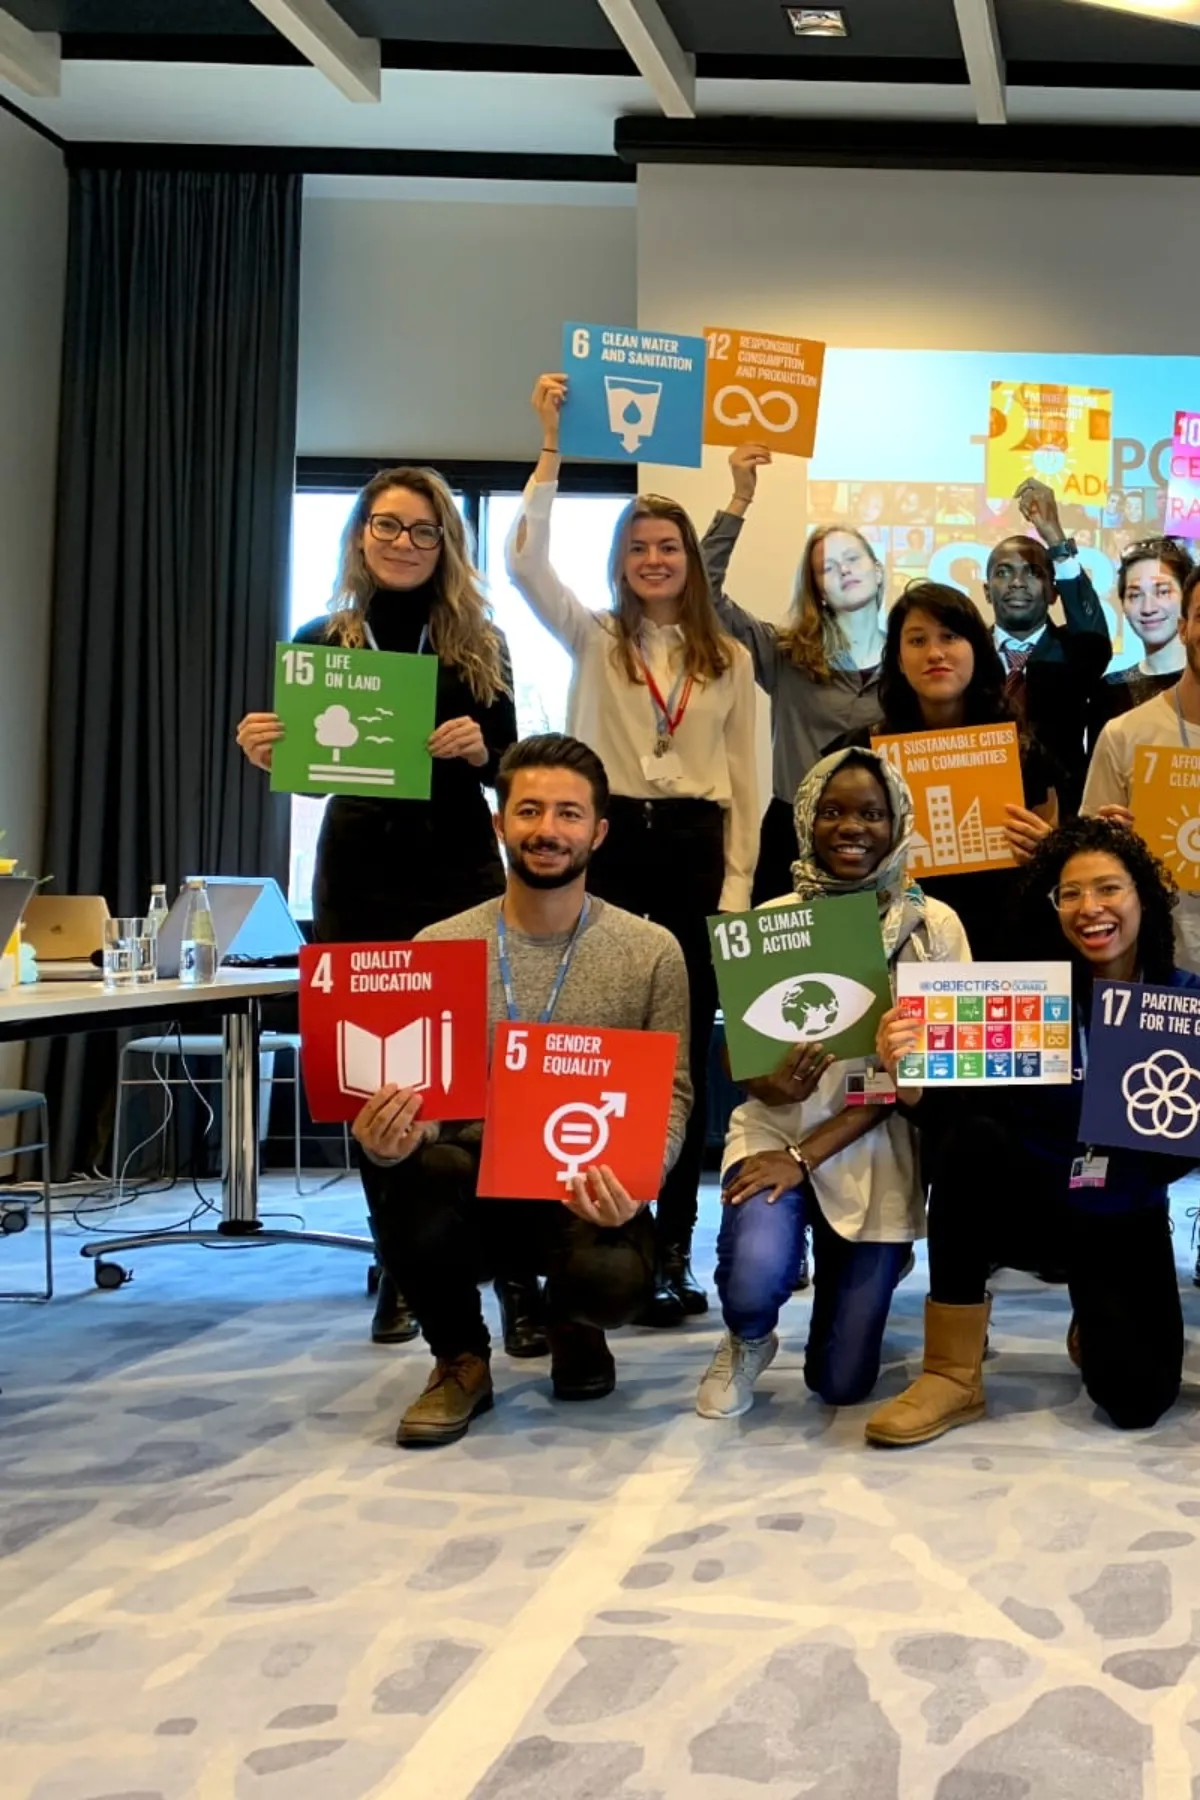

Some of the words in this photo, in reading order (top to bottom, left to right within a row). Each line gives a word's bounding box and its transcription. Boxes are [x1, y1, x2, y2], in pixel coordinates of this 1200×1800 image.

[572, 329, 591, 359] 6
[602, 331, 638, 349] CLEAN
[641, 336, 679, 353] WATER
[707, 332, 731, 360] 12
[602, 350, 625, 363] AND
[628, 352, 692, 372] SANITATION
[738, 351, 805, 371] CONSUMPTION
[735, 365, 757, 379] AND
[759, 368, 817, 387] PRODUCTION
[282, 650, 314, 685] 15
[325, 653, 351, 670] LIFE
[325, 673, 343, 689] ON
[348, 675, 382, 692] LAND
[904, 733, 977, 755] SUSTAINABLE
[979, 730, 1014, 747] CITIES
[906, 758, 929, 774] AND
[932, 749, 1008, 770] COMMUNITIES
[1144, 752, 1158, 784] 7
[758, 908, 815, 934] CLIMATE
[713, 920, 752, 961] 13
[762, 929, 811, 955] ACTION
[351, 949, 413, 971] QUALITY
[310, 952, 333, 994] 4
[350, 971, 432, 993] EDUCATION
[933, 980, 999, 992] OBJECTIFS
[1100, 988, 1131, 1027] 17
[1139, 1012, 1164, 1031] FOR
[1168, 1014, 1191, 1034] THE
[505, 1030, 529, 1071] 5
[545, 1033, 602, 1055] GENDER
[543, 1055, 612, 1077] EQUALITY
